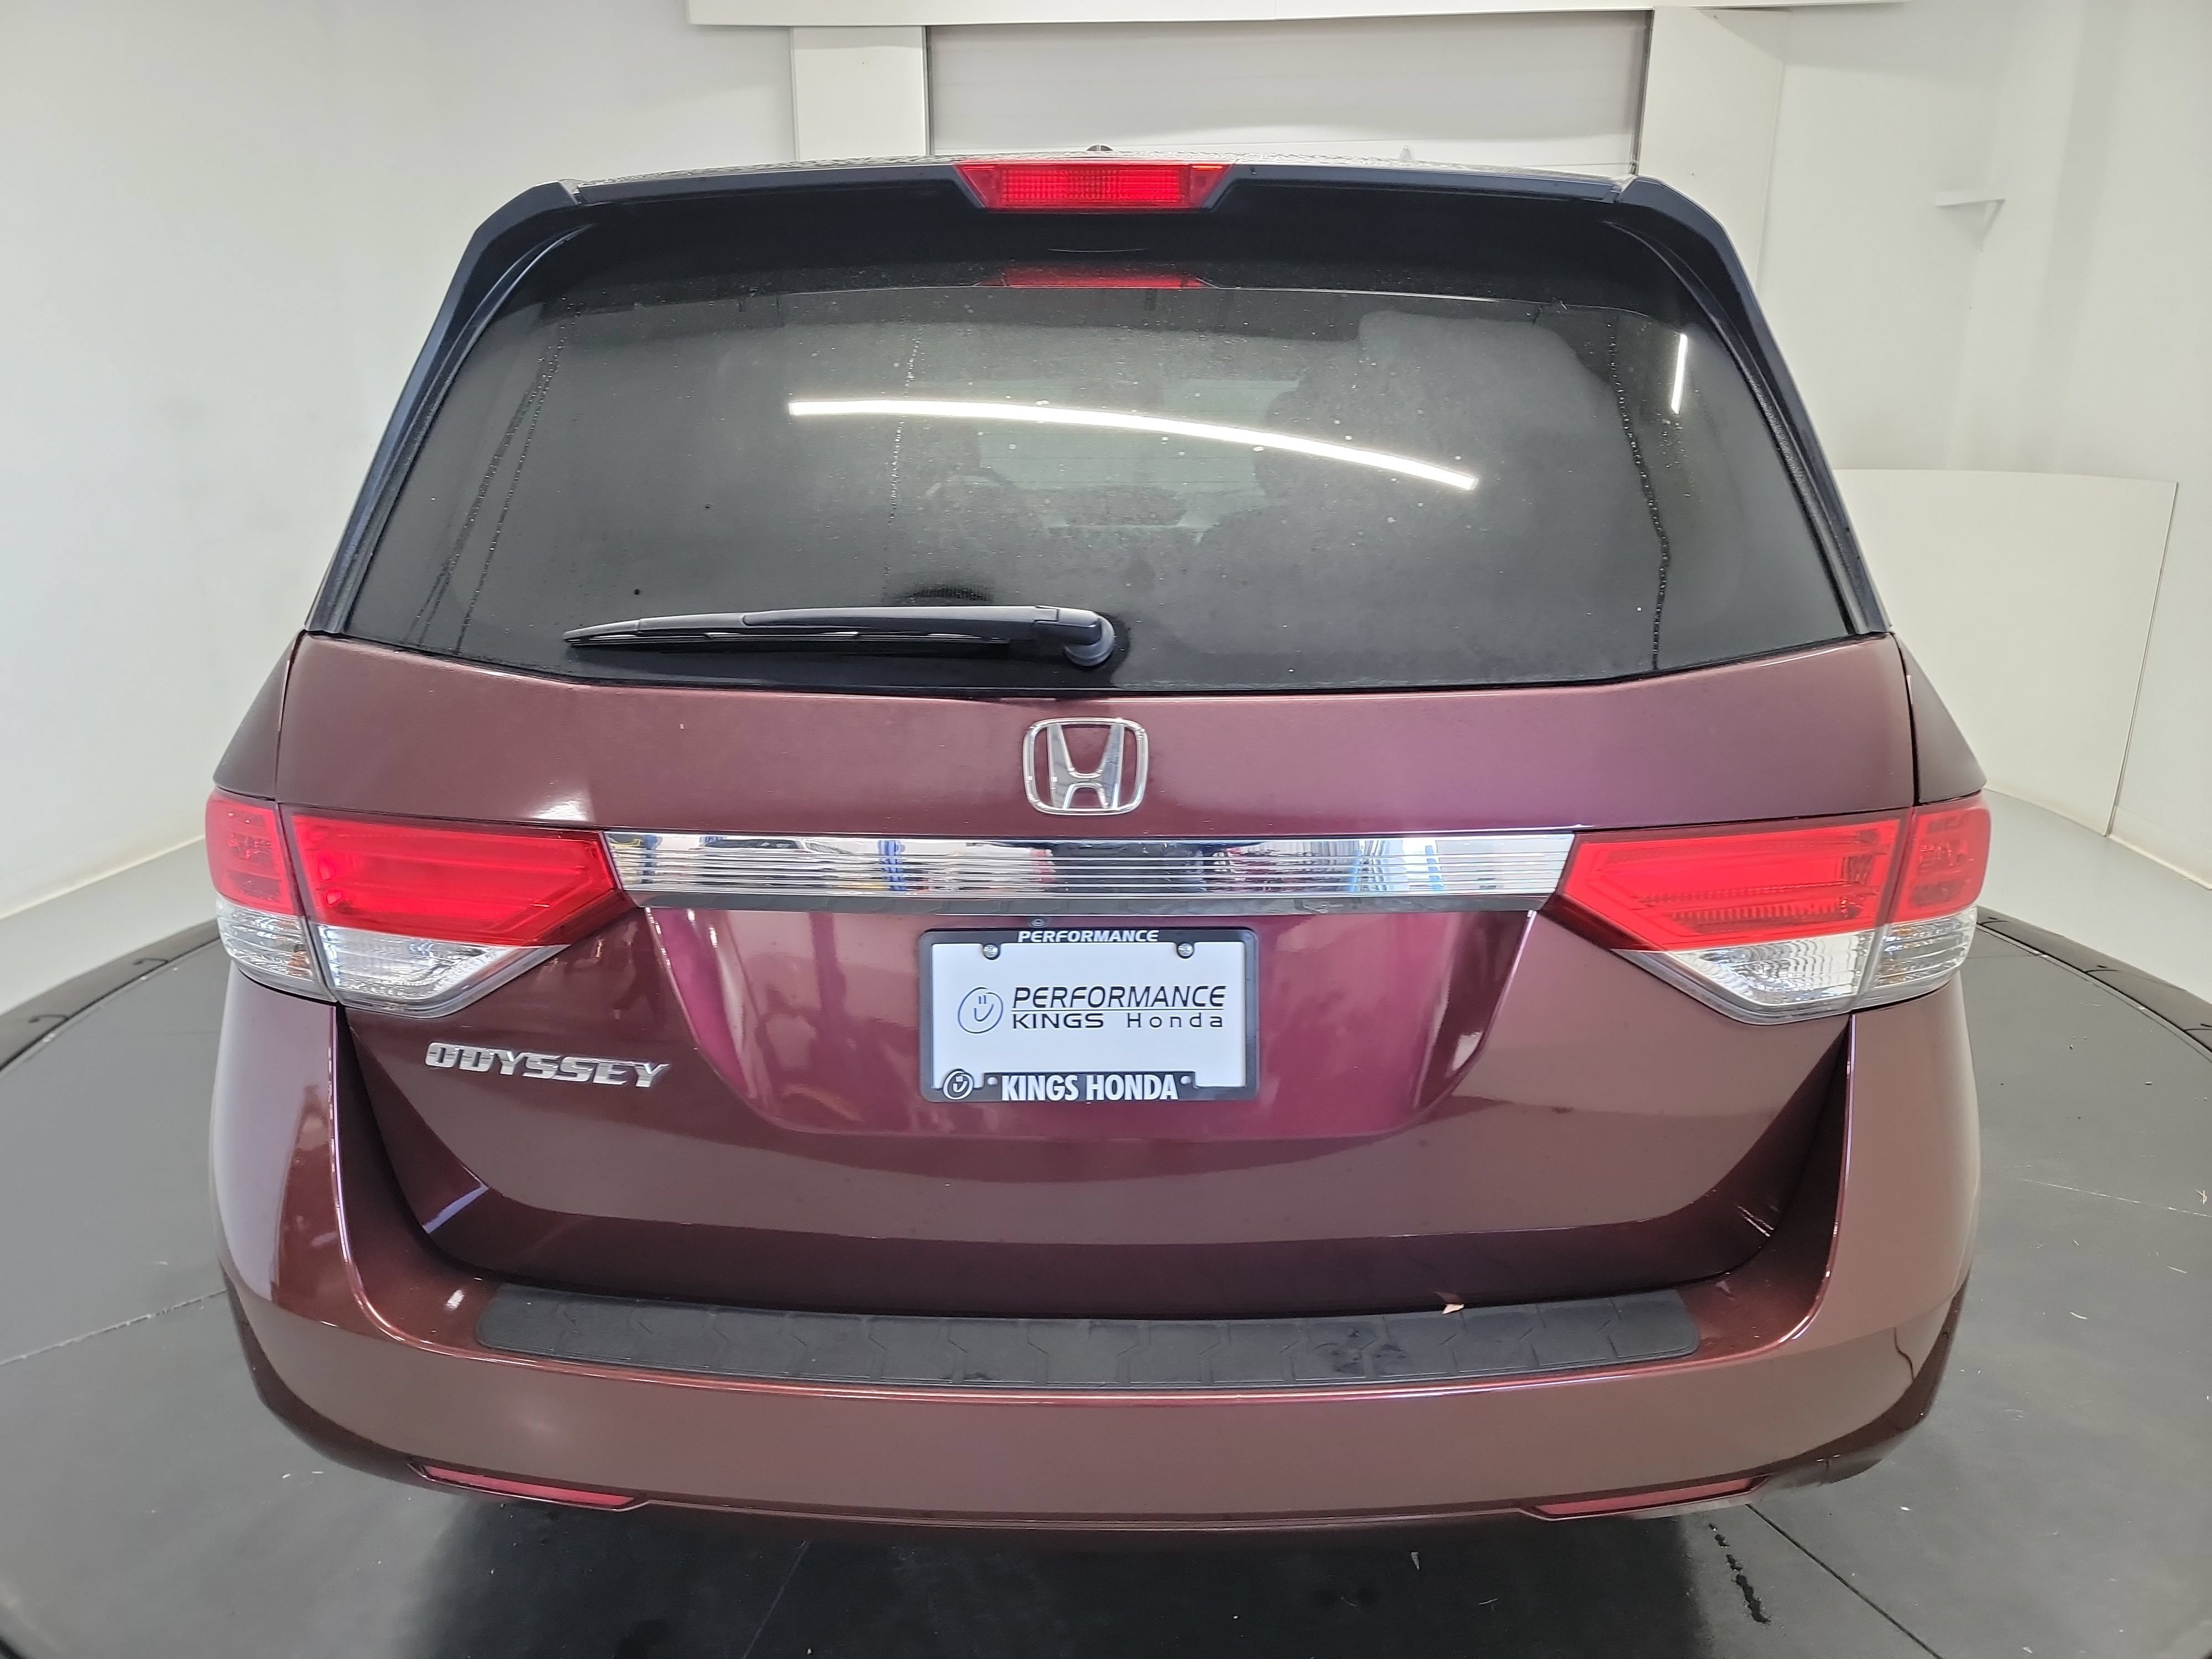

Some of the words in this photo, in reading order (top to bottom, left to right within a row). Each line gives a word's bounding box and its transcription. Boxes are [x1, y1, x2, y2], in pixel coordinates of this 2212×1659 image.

[1018, 930, 1159, 943] PERFORMANCE
[1012, 986, 1226, 1008] PERFORMANCE
[1013, 1014, 1104, 1029] KINGS
[1126, 1013, 1224, 1029] Honda
[425, 1042, 670, 1088] ODYSSEY
[1001, 1075, 1079, 1101] KINGS
[1087, 1074, 1178, 1100] HONDA
